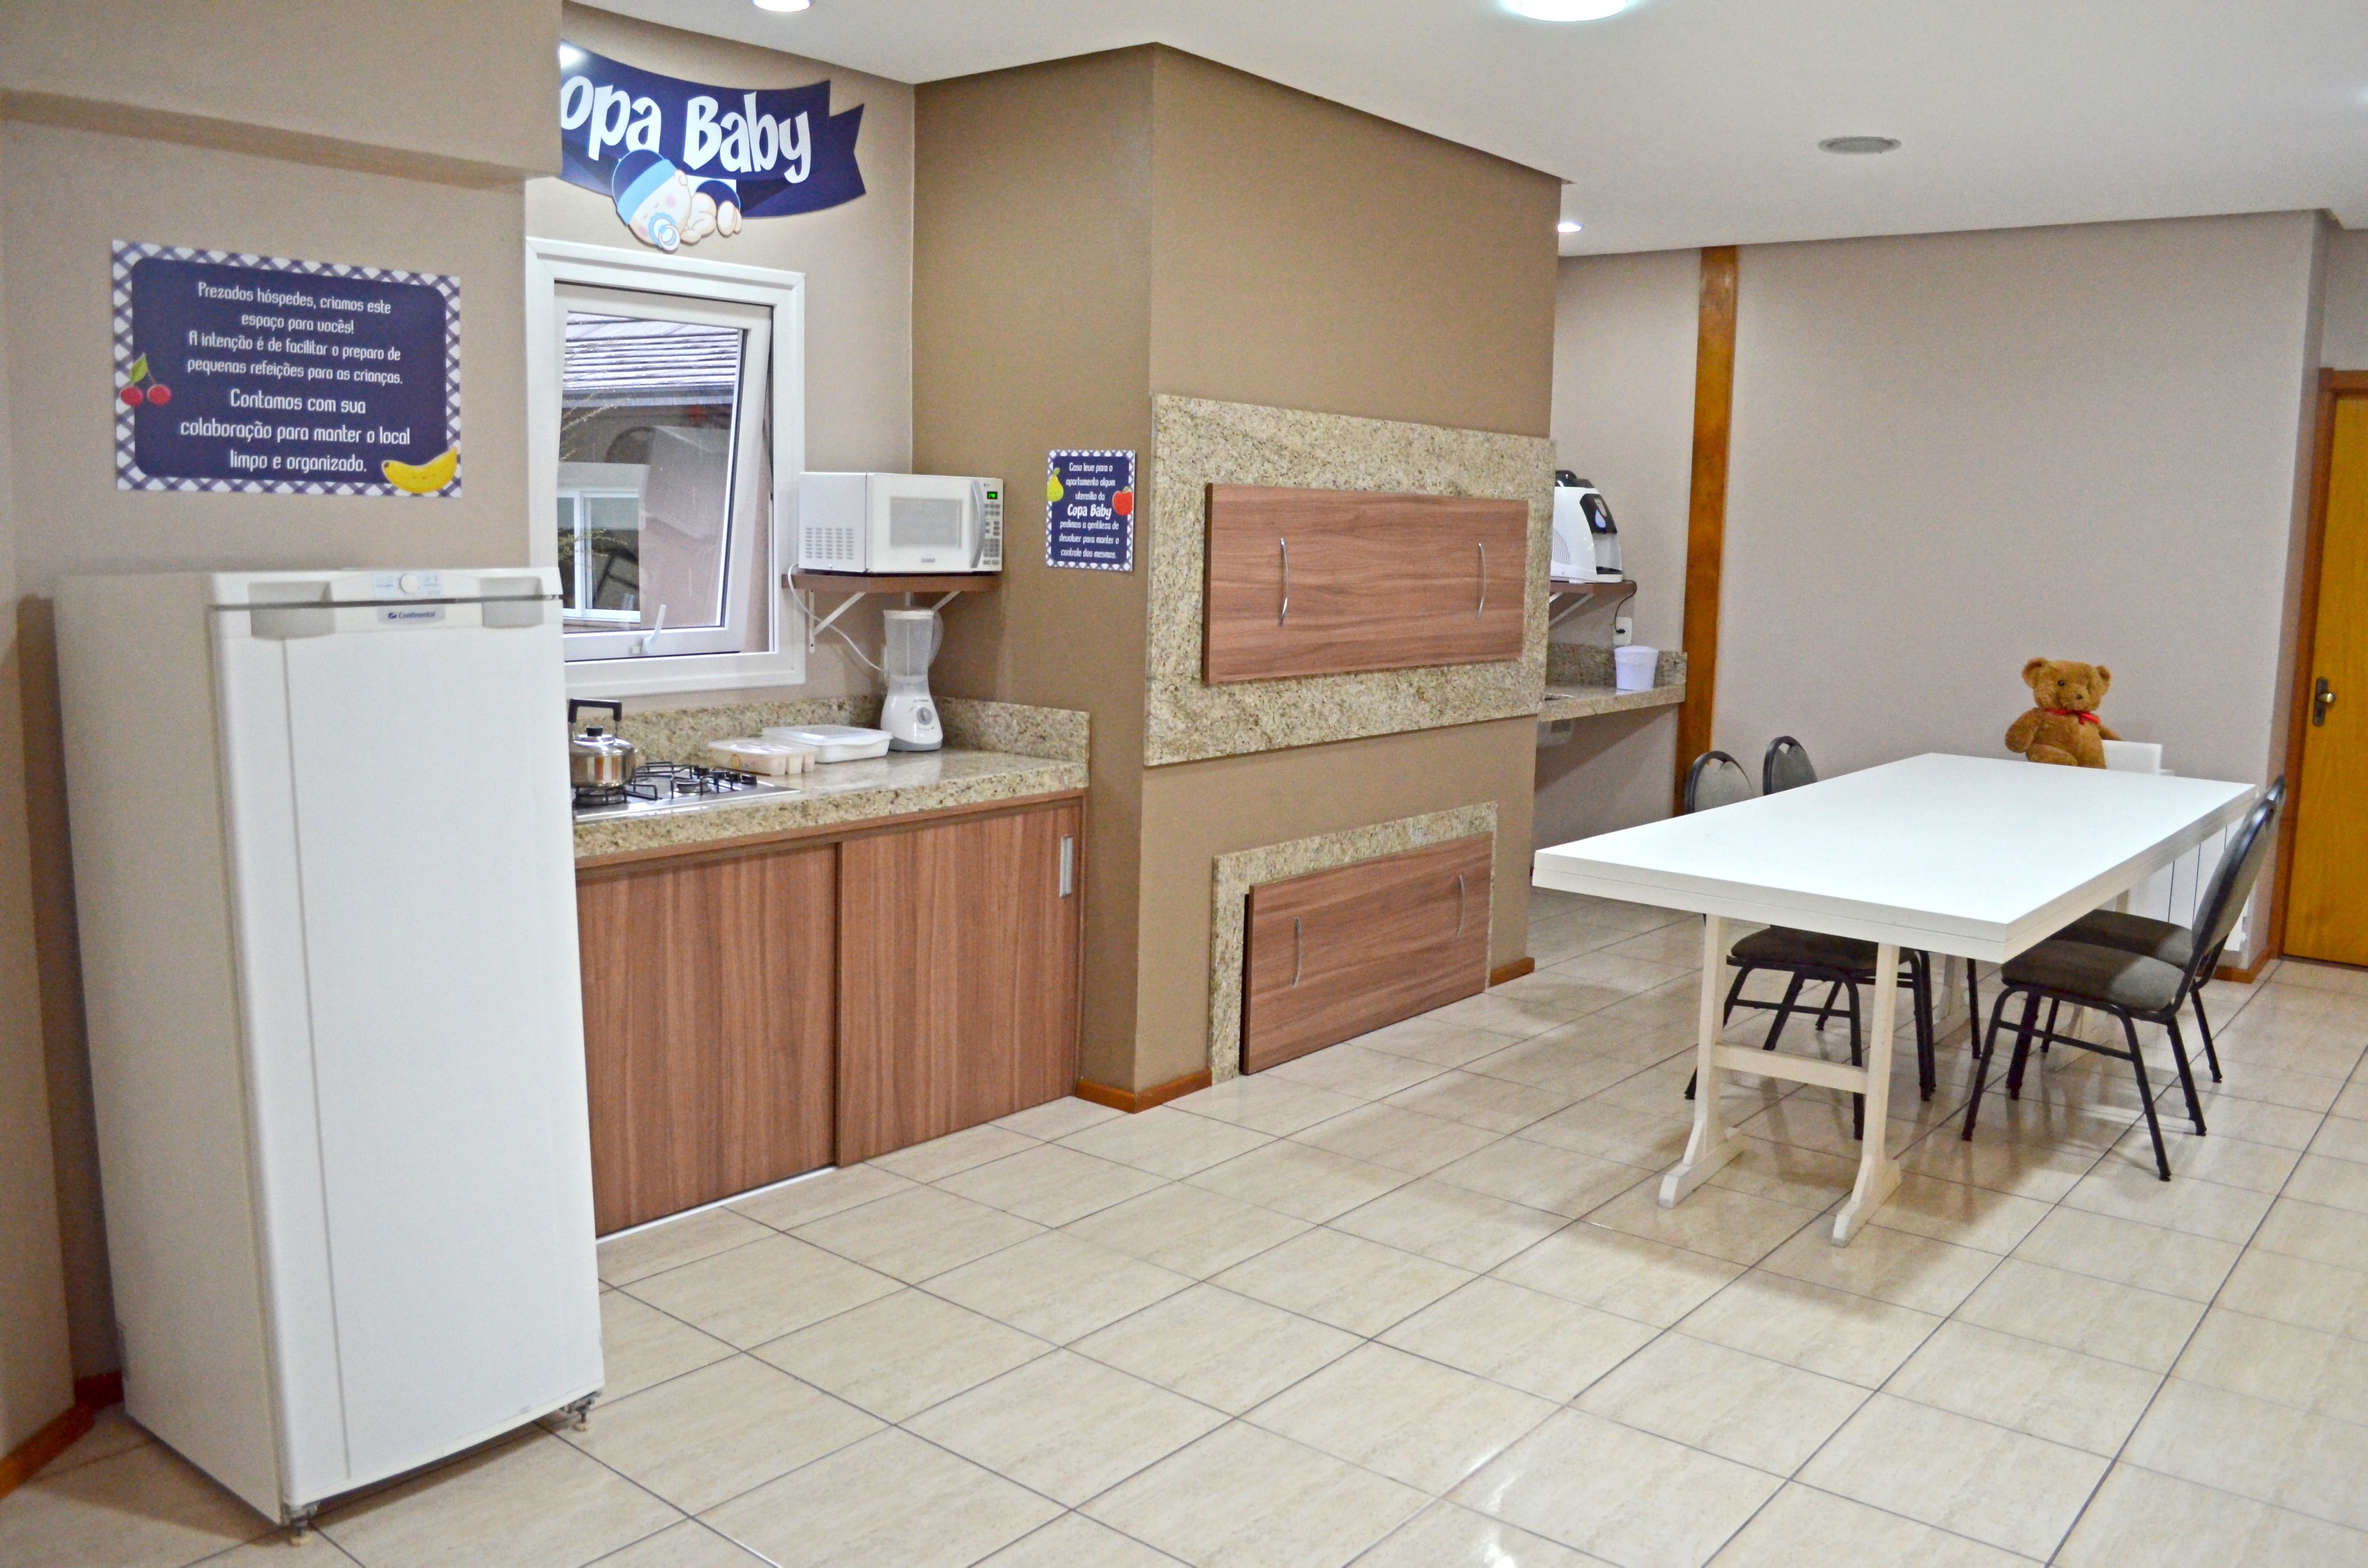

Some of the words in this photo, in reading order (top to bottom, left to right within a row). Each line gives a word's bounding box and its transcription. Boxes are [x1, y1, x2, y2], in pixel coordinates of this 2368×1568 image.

[561, 76, 662, 161] opa
[683, 91, 812, 184] Baby
[198, 281, 253, 302] Prezados
[257, 287, 316, 310] hóspedes,
[320, 296, 364, 311] criamos
[367, 299, 391, 314] este
[241, 314, 284, 331] espaço
[288, 319, 314, 332] para
[317, 319, 354, 334] vocês!
[189, 330, 198, 346] A
[201, 332, 253, 352] intenção
[257, 336, 264, 351] é
[268, 337, 282, 352] de
[286, 339, 328, 356] facilitar
[332, 346, 339, 356] o
[342, 347, 384, 362] preparo
[387, 346, 401, 361] de
[187, 359, 247, 376] pequenas
[250, 360, 305, 379] refeições
[308, 368, 334, 381] para
[336, 369, 350, 380] as
[353, 369, 403, 387] crianças.
[230, 388, 303, 410] Contamos
[307, 398, 336, 413] com
[340, 400, 366, 414] sua
[180, 417, 272, 443] colaboração
[277, 426, 309, 443] para
[313, 424, 362, 443] manter
[366, 430, 375, 443] o
[379, 426, 411, 445] local
[230, 449, 268, 472] limpo
[273, 456, 282, 469] e
[286, 454, 367, 474] organizado.
[1069, 462, 1082, 472] Caso
[1083, 462, 1095, 472] leve
[1096, 464, 1108, 473] para
[1066, 477, 1098, 486] apartamento
[1100, 477, 1116, 488] algum
[1098, 492, 1105, 500] da
[1067, 504, 1087, 519] Copa
[1090, 504, 1112, 520] Baby
[1112, 521, 1119, 530] de
[1083, 535, 1095, 544] para
[1096, 535, 1113, 544] manter
[1061, 548, 1082, 556] controle
[1083, 549, 1093, 557] dos
